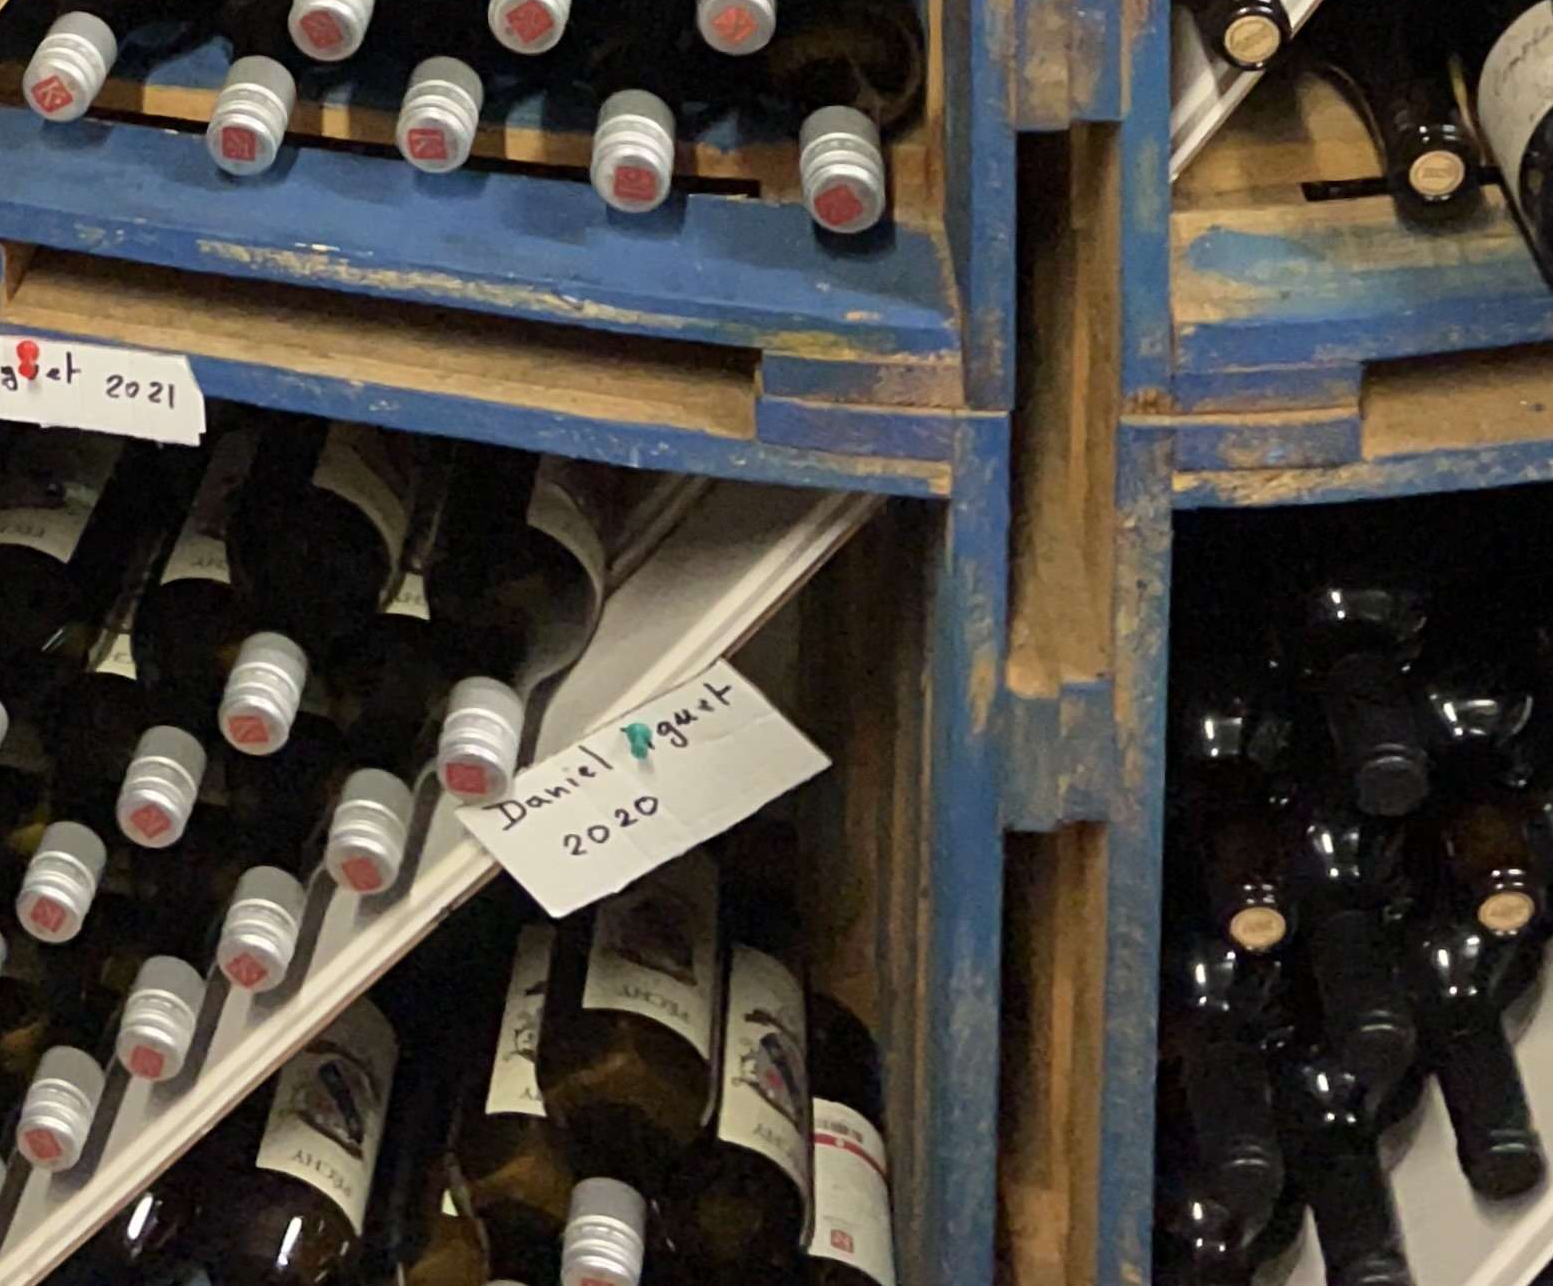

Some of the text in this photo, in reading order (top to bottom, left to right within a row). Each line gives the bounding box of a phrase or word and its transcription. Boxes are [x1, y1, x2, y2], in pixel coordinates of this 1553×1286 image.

[105, 374, 177, 409] 2021
[482, 745, 615, 831] Daniel
[563, 794, 660, 857] 2020
